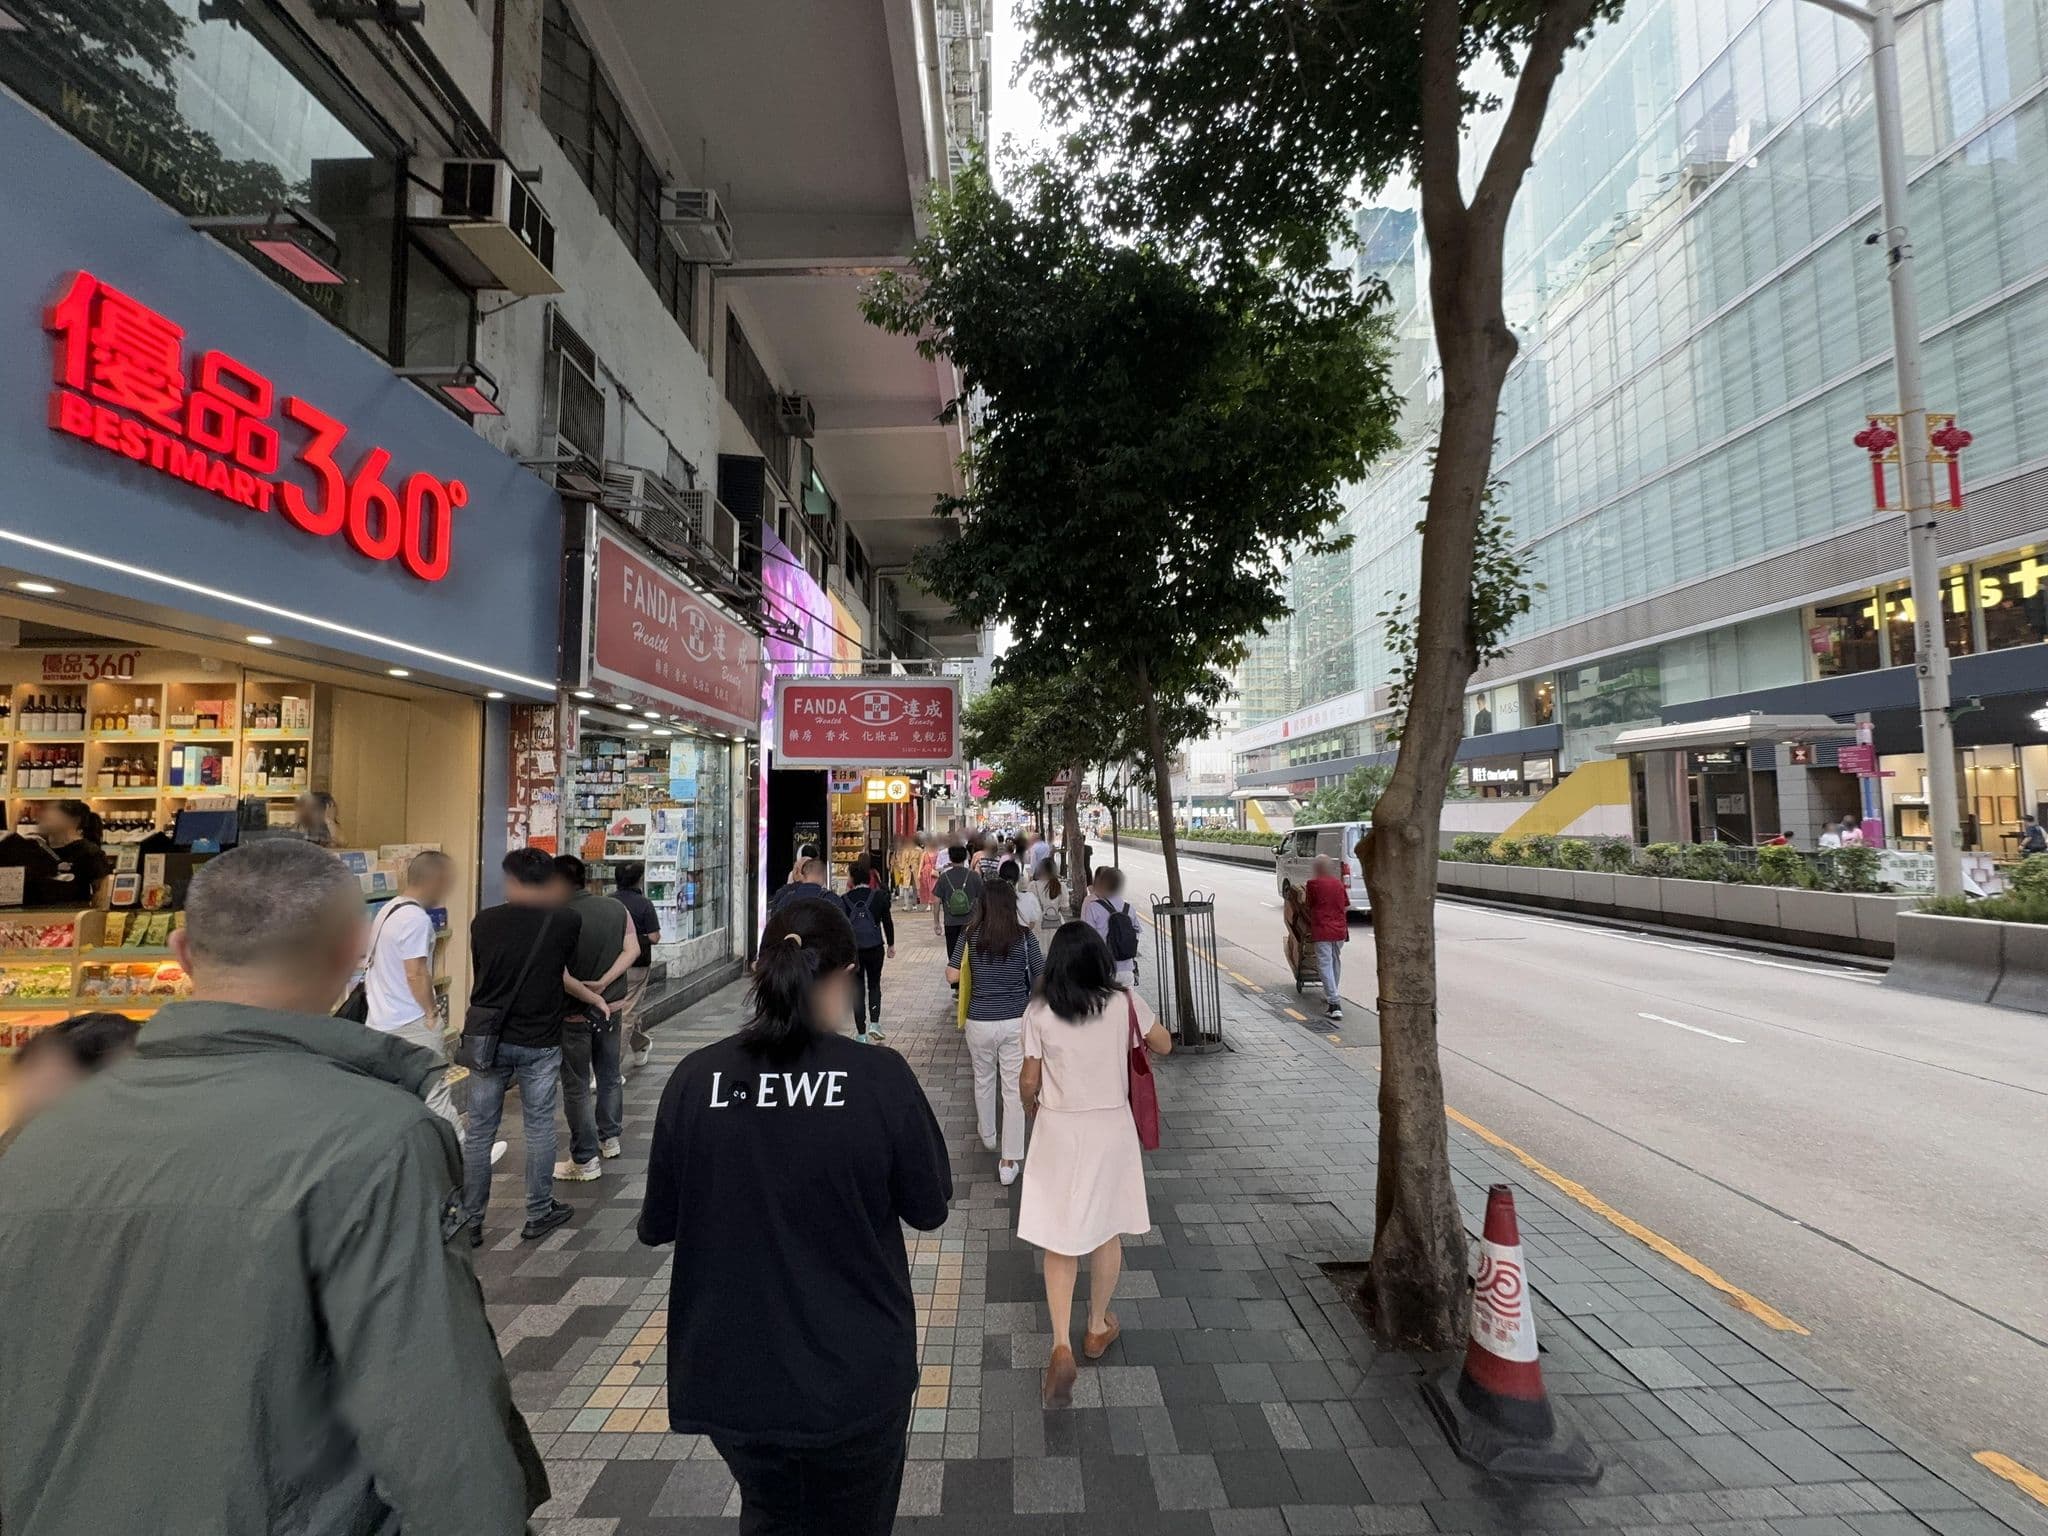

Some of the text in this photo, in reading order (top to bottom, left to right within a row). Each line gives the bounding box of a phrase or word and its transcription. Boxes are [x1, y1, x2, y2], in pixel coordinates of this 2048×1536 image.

[49, 390, 275, 513] BESTMART
[623, 565, 678, 632] FANDA
[632, 621, 671, 655] Health
[794, 698, 848, 715] FANDA
[902, 698, 943, 718] 達成
[1499, 700, 1519, 715] M&S
[815, 717, 935, 726] Health Beauty
[789, 729, 813, 742] 藥房
[825, 729, 850, 742] 香水
[861, 730, 899, 742] 化妝品
